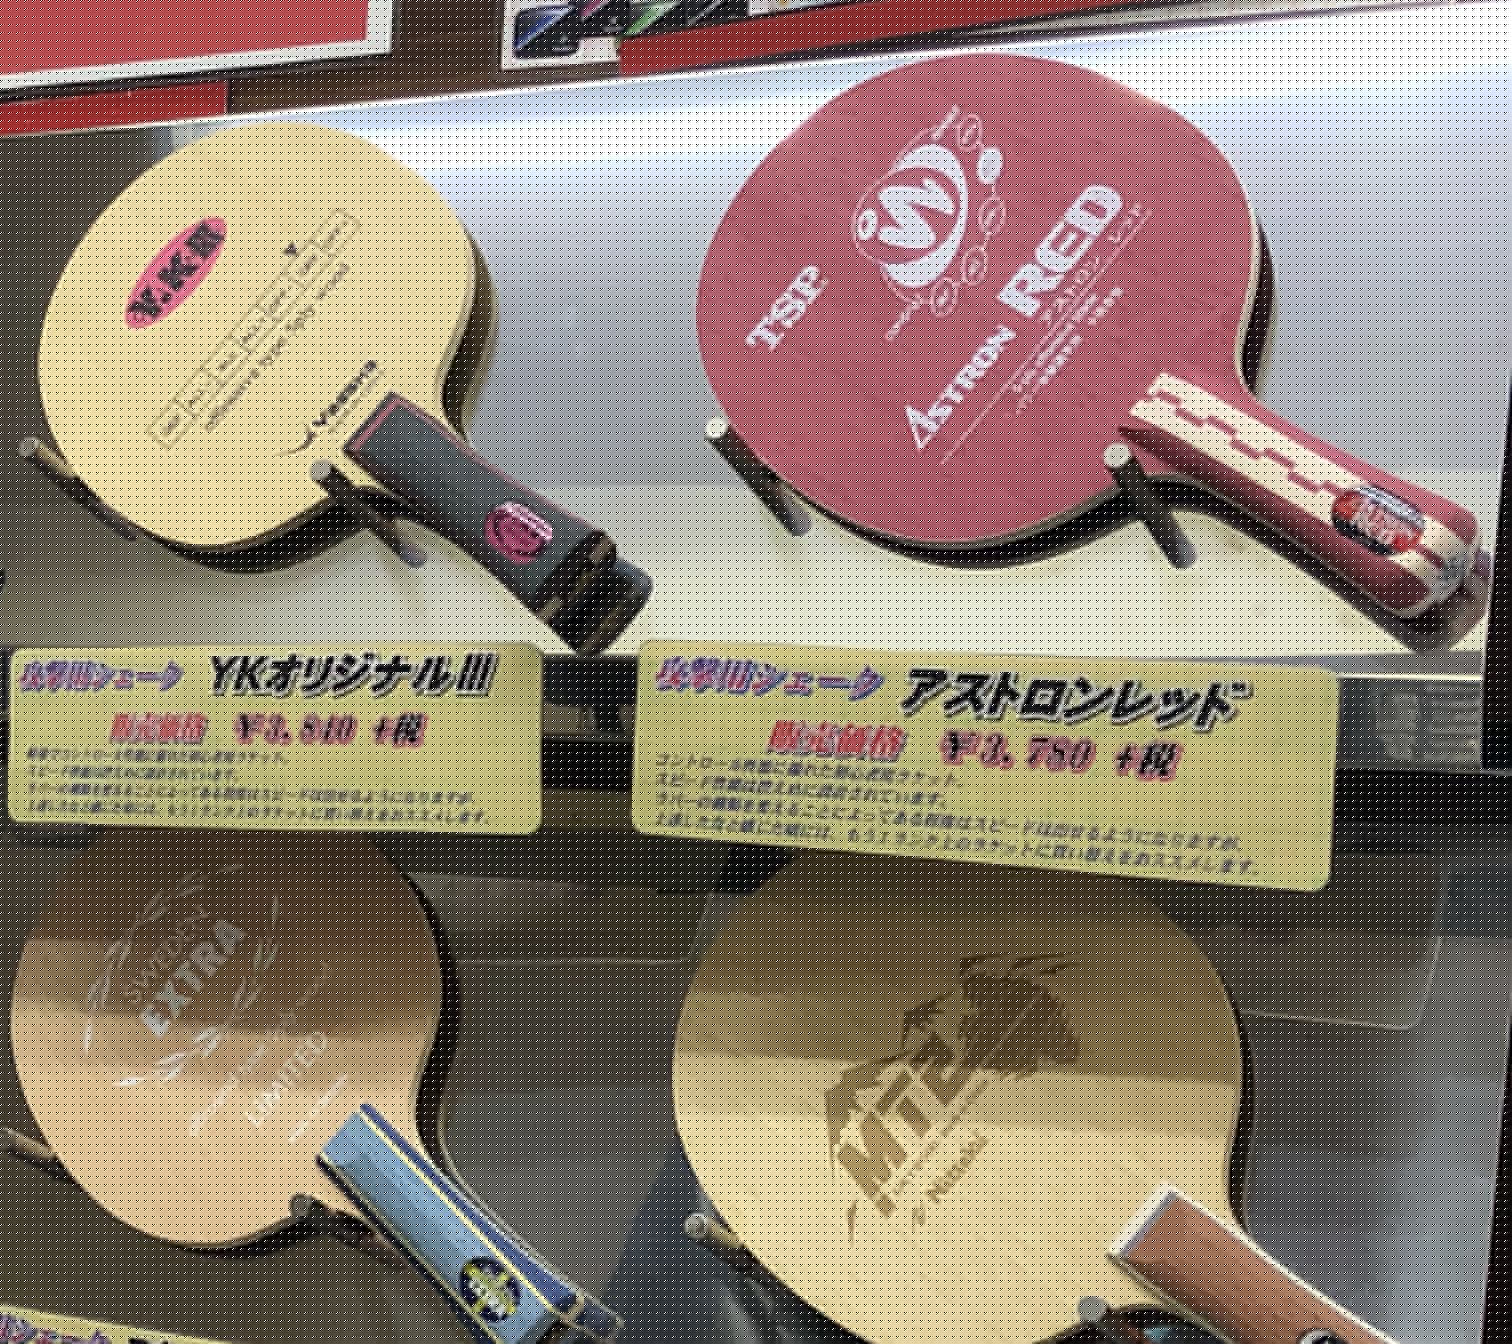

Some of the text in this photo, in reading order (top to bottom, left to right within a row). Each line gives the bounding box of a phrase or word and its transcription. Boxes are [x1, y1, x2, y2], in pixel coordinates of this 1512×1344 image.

[995, 183, 1127, 319] RED
[745, 264, 830, 353] TSP
[897, 665, 1256, 736] アストロンレッド
[141, 918, 248, 1038] EXTRA
[244, 1030, 331, 1131] LIMITED
